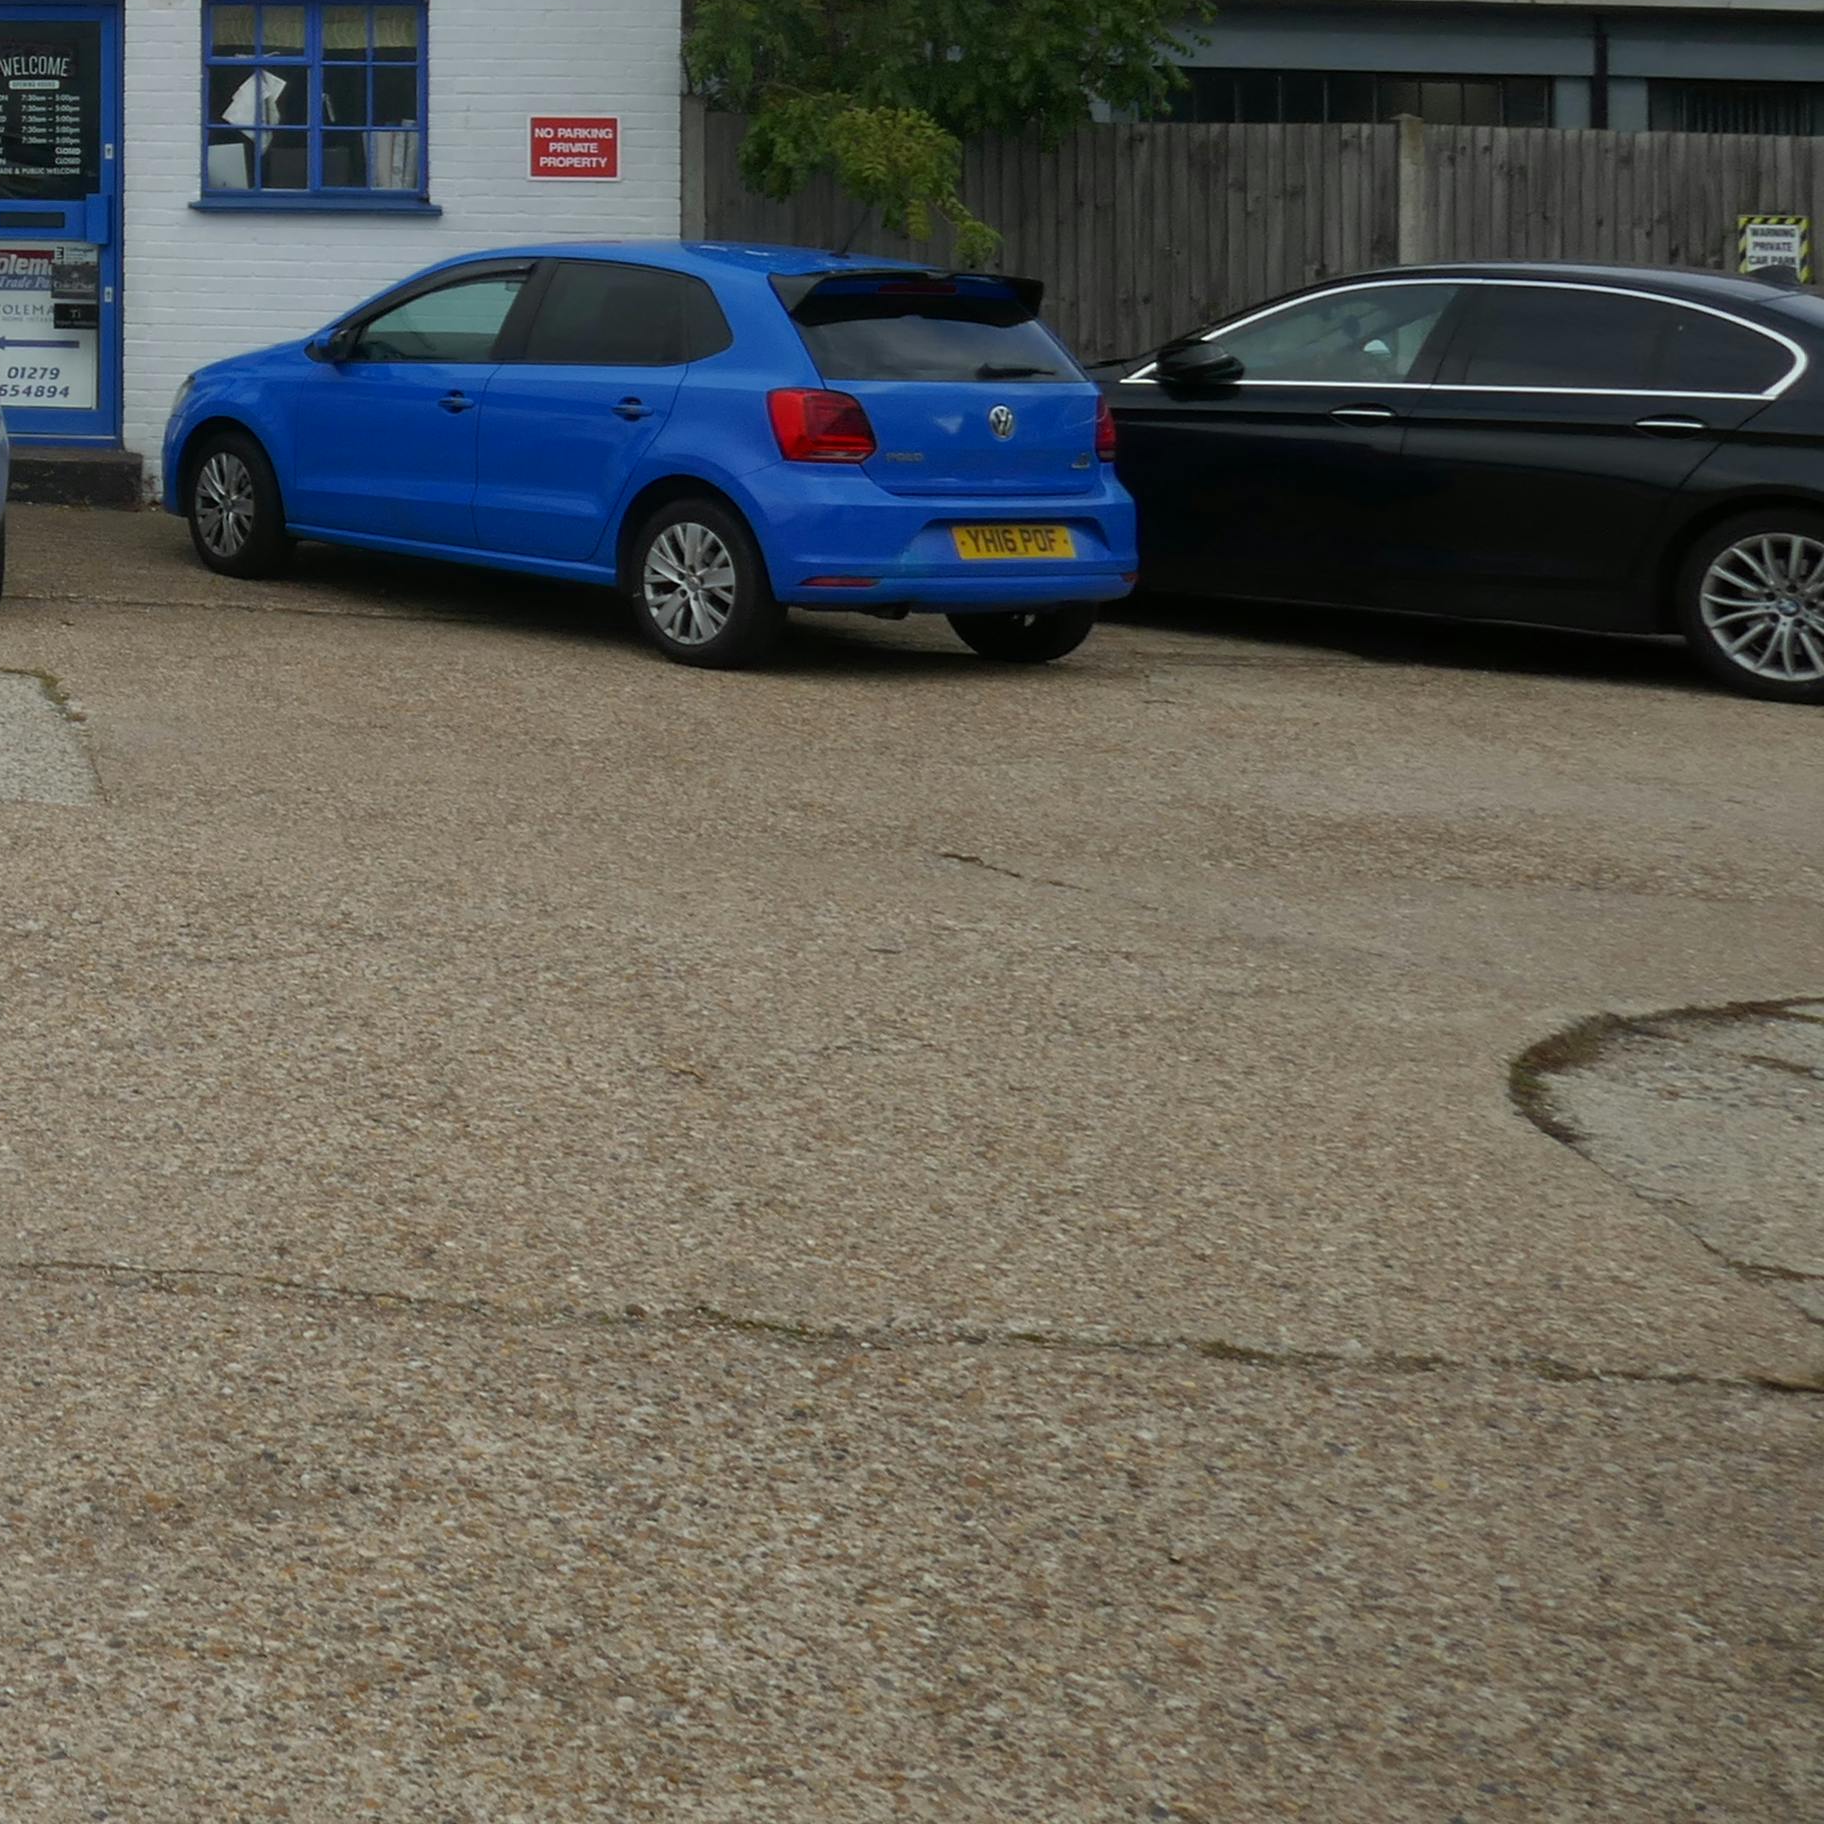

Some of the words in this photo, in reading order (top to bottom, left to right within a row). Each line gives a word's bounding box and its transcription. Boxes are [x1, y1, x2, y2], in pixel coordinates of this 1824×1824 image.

[534, 127, 553, 138] NO
[558, 128, 613, 139] PARKING
[55, 147, 81, 155] CLOSED
[549, 142, 598, 153] PRIVATE
[55, 157, 81, 165] CLOSED
[539, 157, 608, 167] PROPERTY
[22, 167, 44, 175] PUBLIC
[46, 167, 80, 175] WELCOME
[1751, 228, 1796, 237] WARNING
[1752, 241, 1793, 251] PRIVATE
[0, 276, 31, 288] Trade
[7, 366, 60, 380] 01279
[965, 528, 1017, 552] YH16
